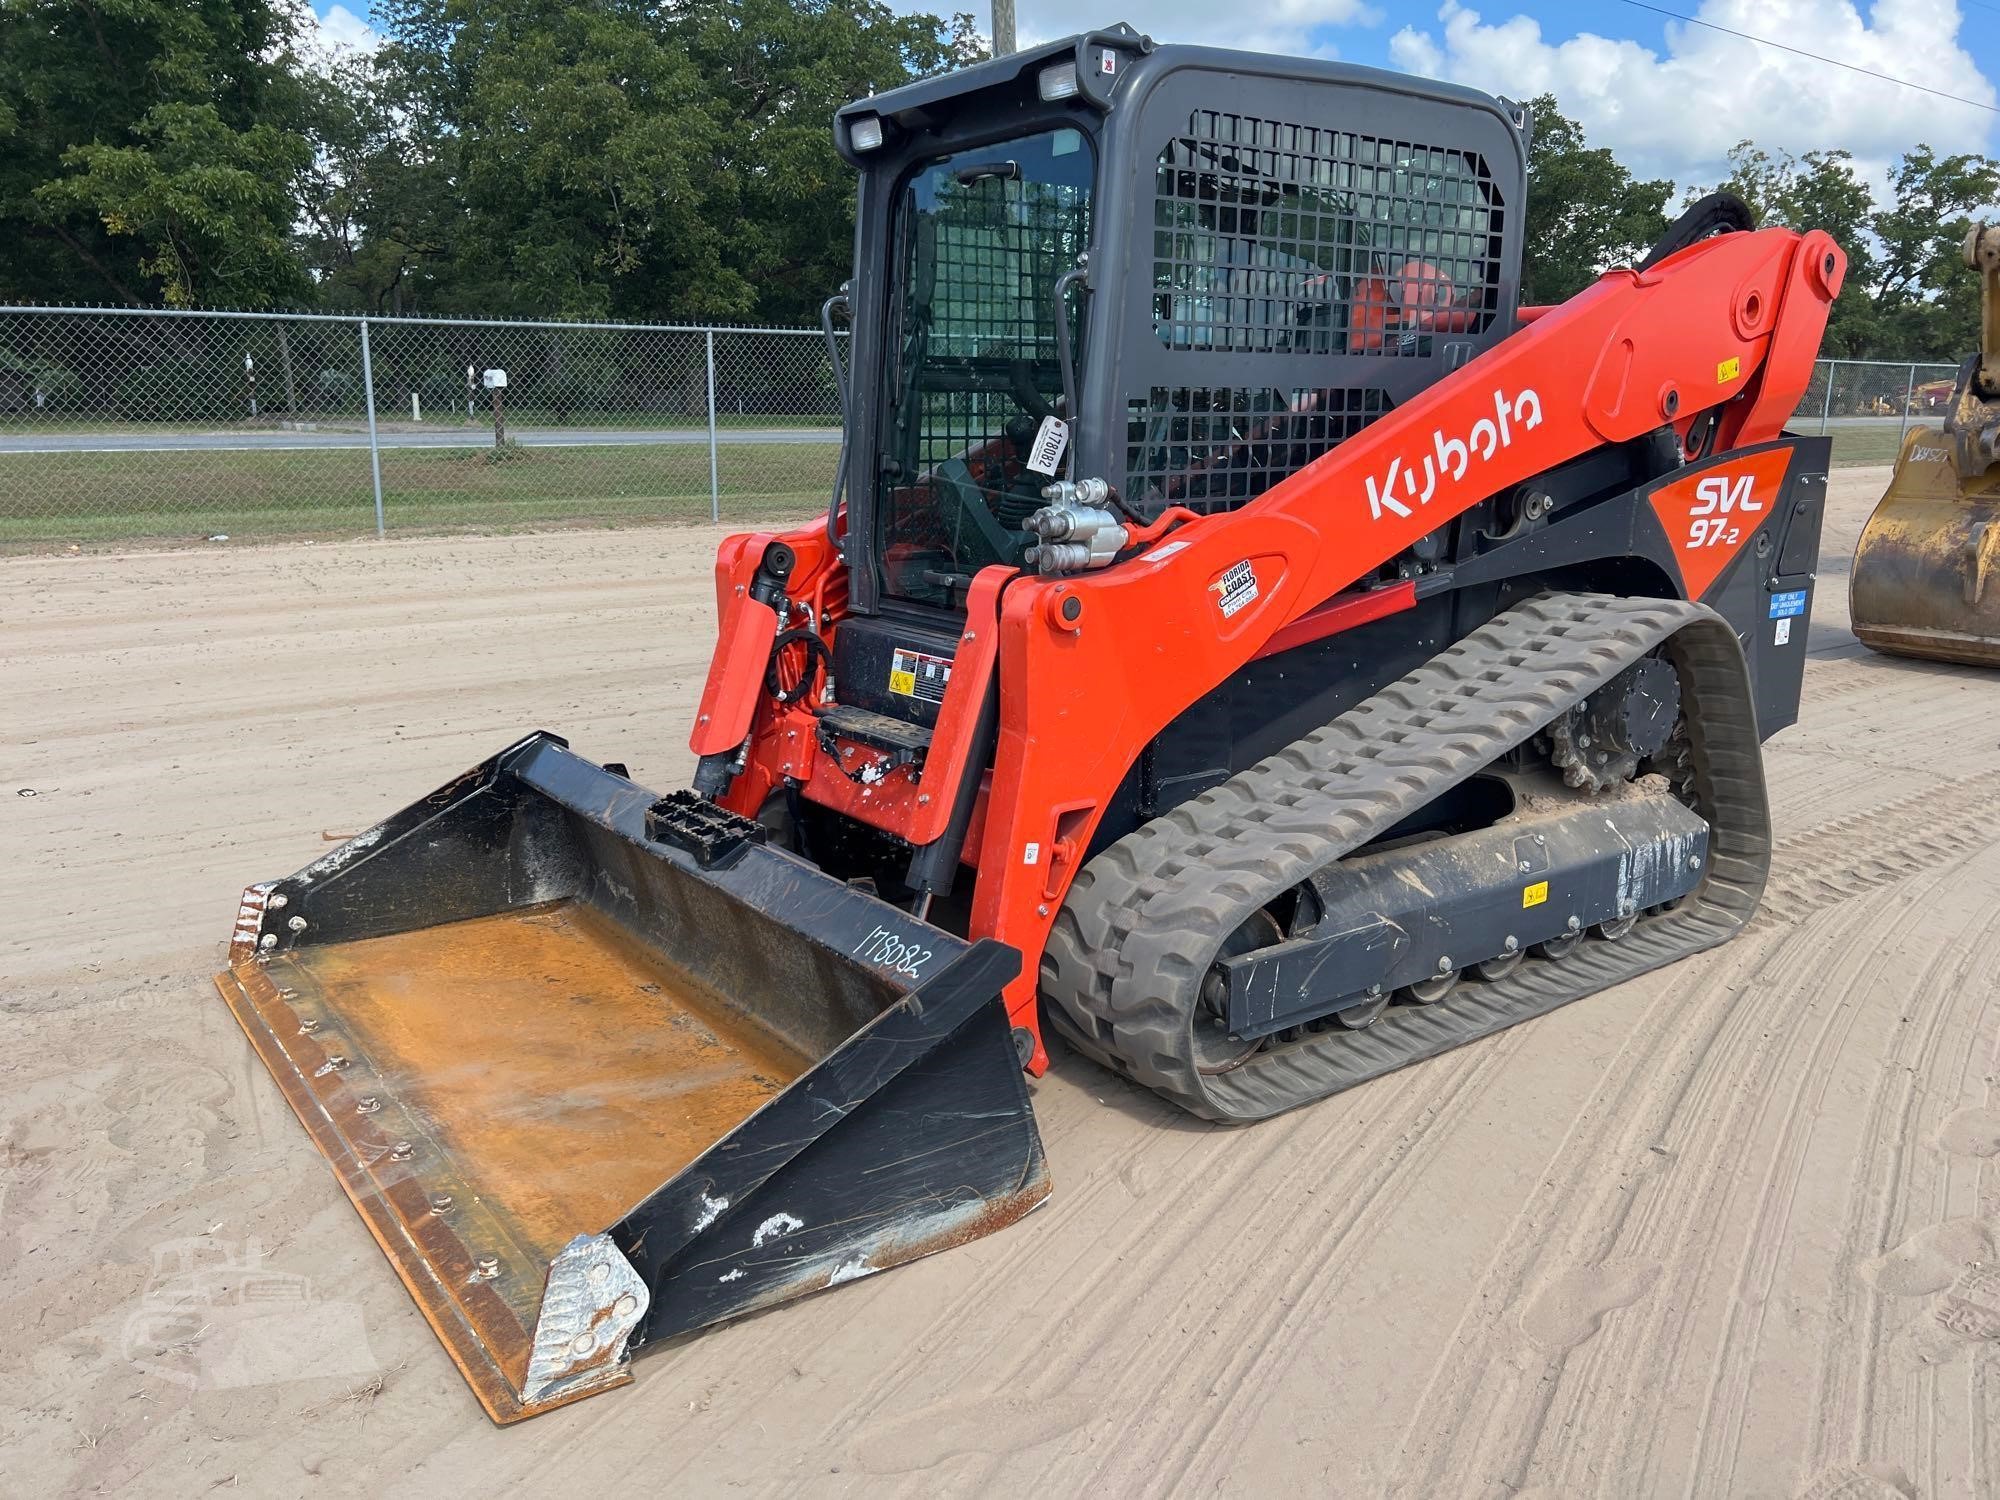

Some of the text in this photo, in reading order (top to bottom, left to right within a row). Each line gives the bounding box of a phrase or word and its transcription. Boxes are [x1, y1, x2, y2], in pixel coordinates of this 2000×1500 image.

[1039, 431, 1063, 468] 178082
[1365, 389, 1543, 521] Kubota
[1689, 475, 1763, 516] SVL
[1686, 518, 1740, 549] 97-2
[1222, 560, 1250, 585] FLORIDA
[1225, 570, 1253, 595] COAST
[853, 925, 933, 979] 178082
